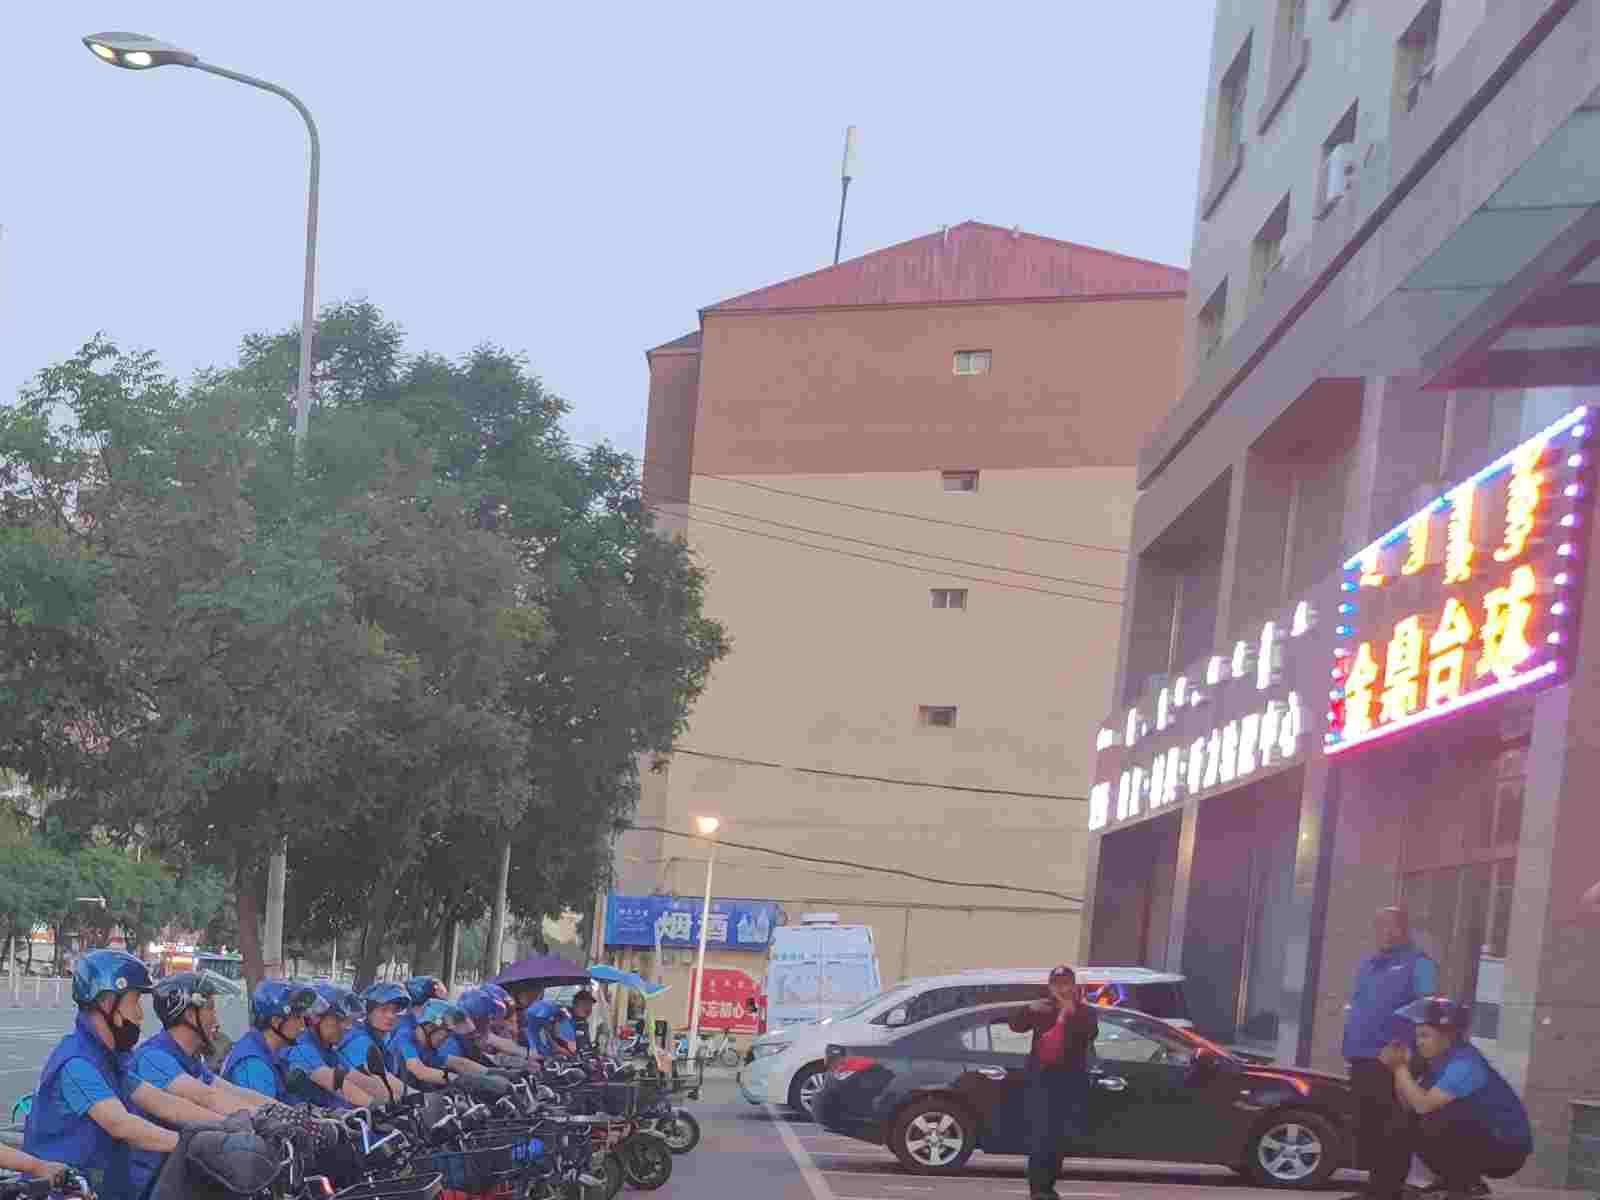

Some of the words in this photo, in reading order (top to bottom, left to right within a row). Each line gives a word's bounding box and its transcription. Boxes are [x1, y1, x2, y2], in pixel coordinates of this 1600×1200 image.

[1343, 565, 1537, 738] 金鼎台球
[655, 911, 729, 943] 烟酒
